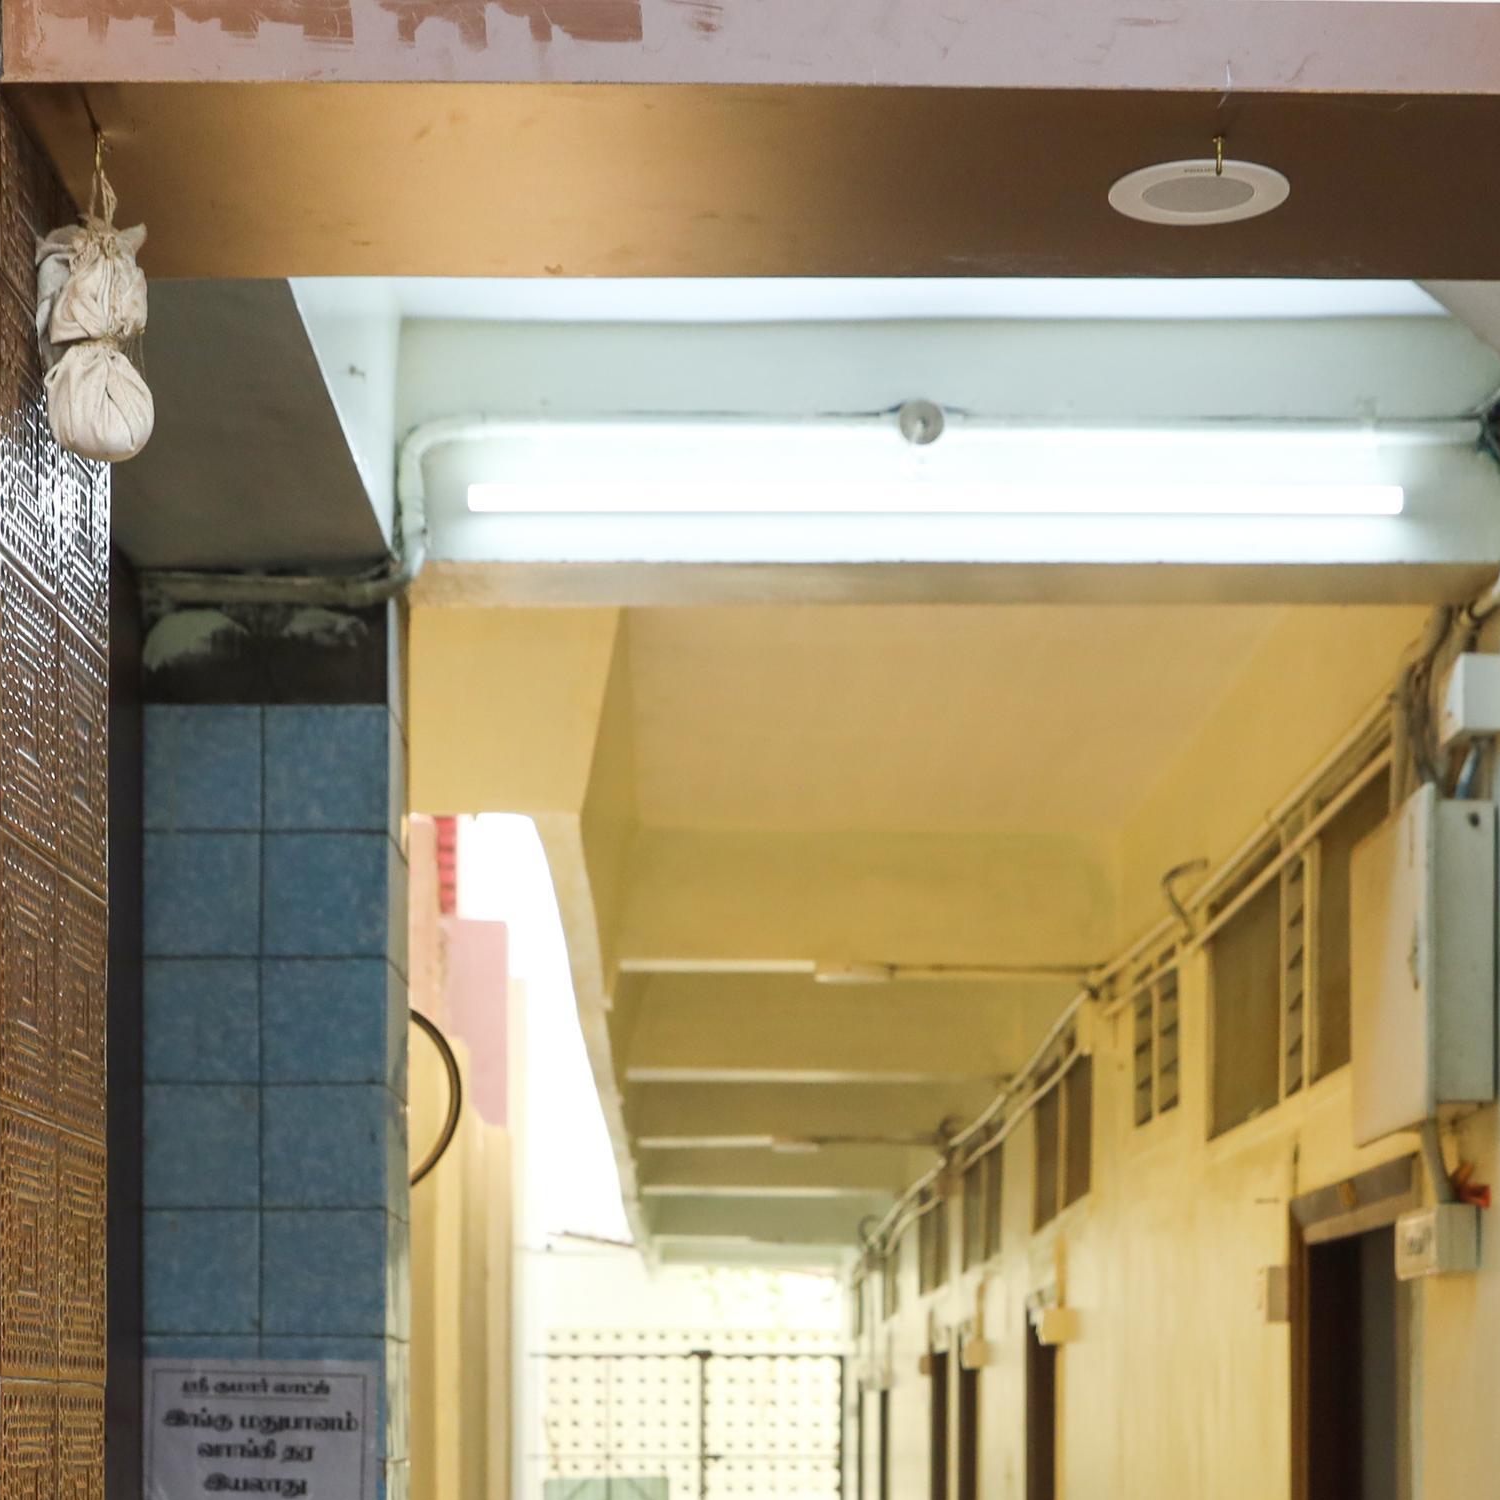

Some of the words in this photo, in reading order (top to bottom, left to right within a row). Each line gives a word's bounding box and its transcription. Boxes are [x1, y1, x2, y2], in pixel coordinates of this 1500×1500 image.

[162, 1408, 233, 1432] இங்கு
[240, 1411, 358, 1435] மதுபானம்
[197, 1438, 277, 1461] வாங்கி
[281, 1444, 316, 1463] தர
[204, 1473, 308, 1497] இயலாது
